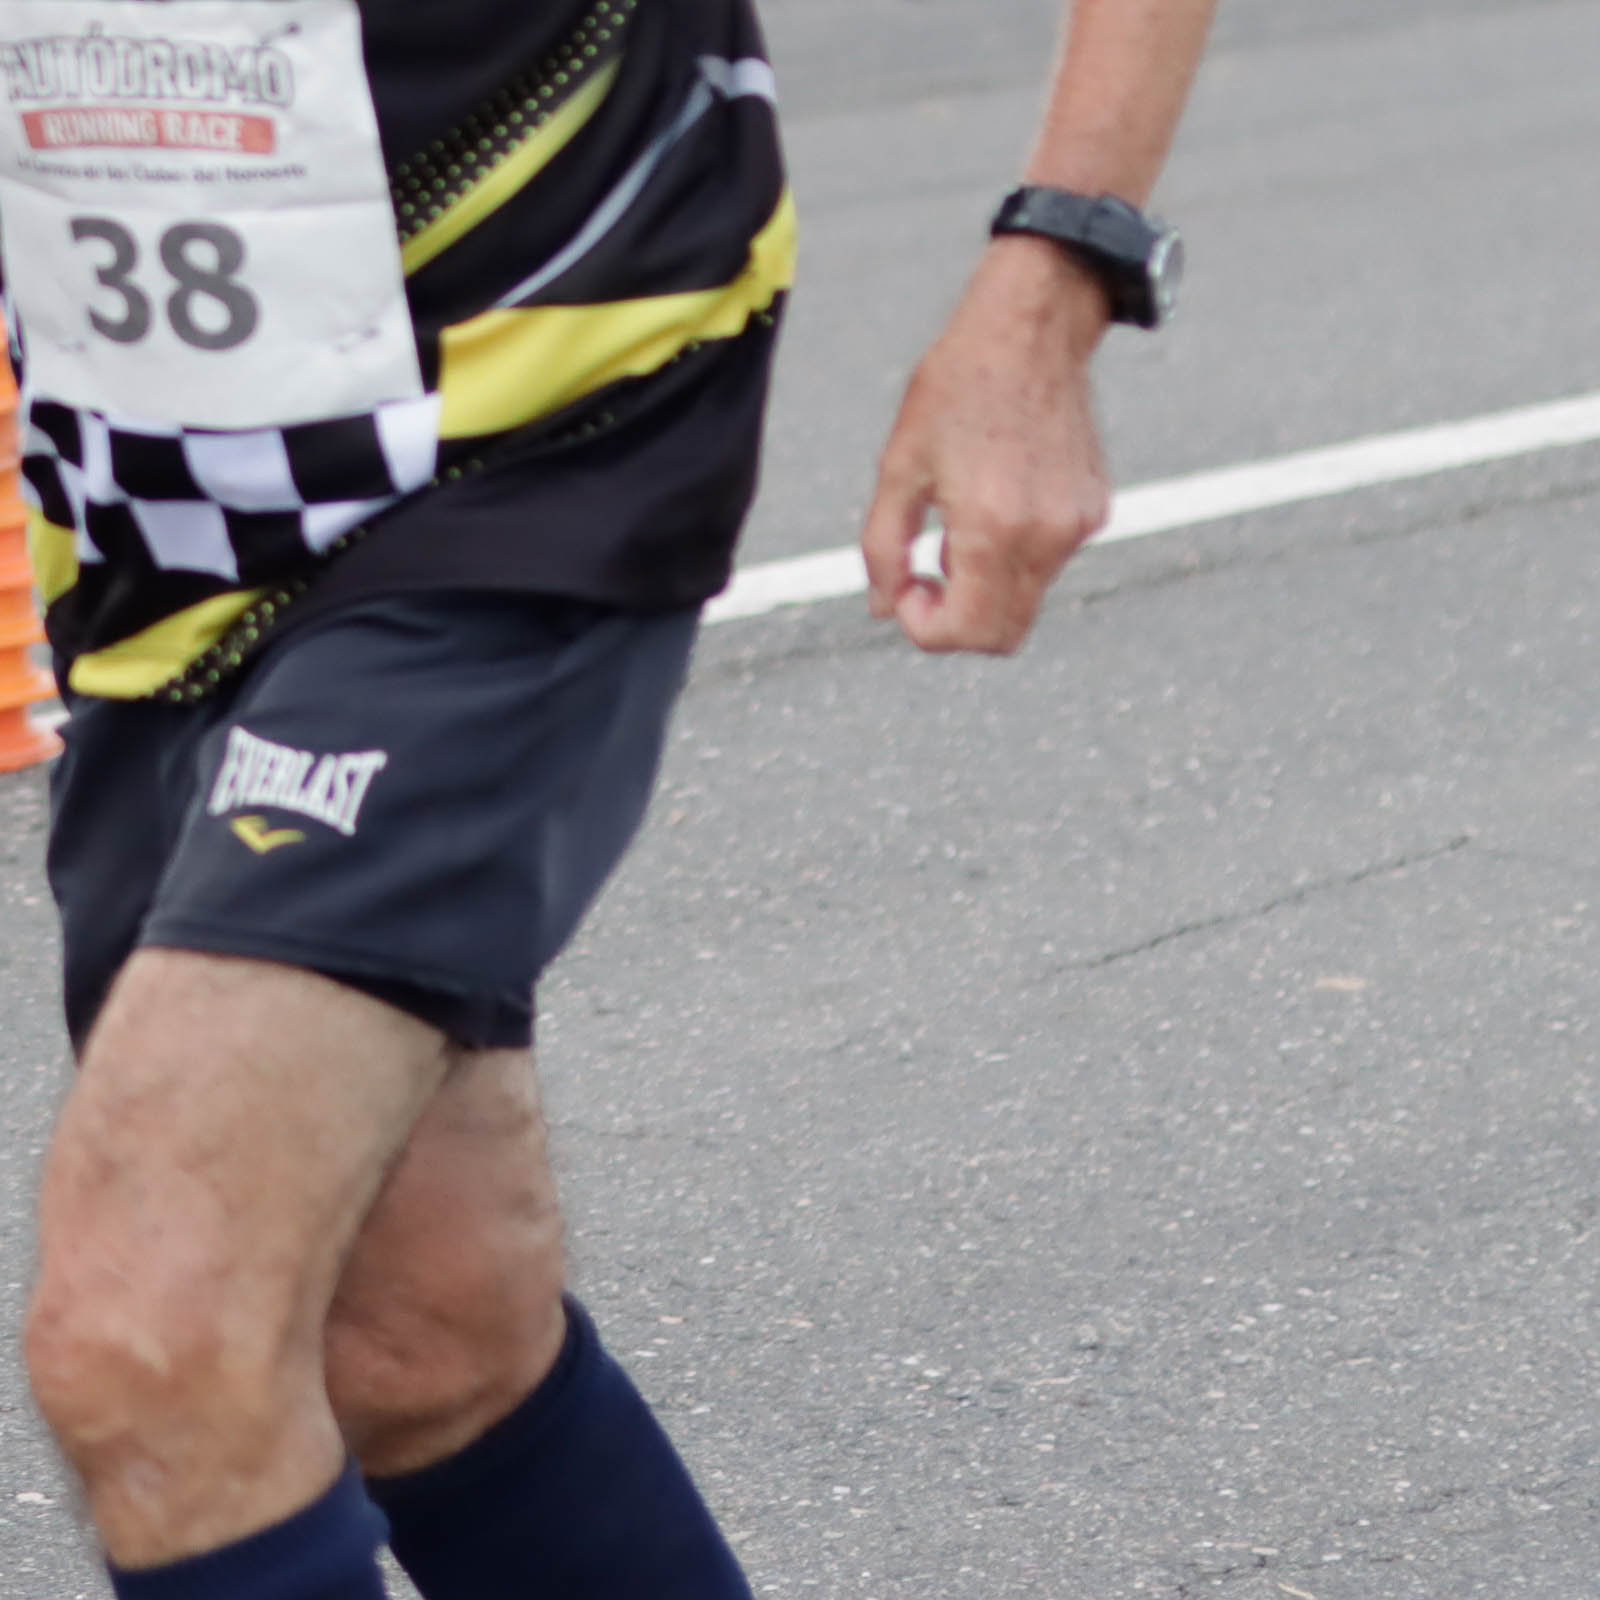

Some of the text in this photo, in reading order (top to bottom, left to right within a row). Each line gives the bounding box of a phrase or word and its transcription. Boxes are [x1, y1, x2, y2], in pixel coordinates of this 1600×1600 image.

[43, 110, 244, 149] RUNNING RACE
[69, 216, 261, 351] 38
